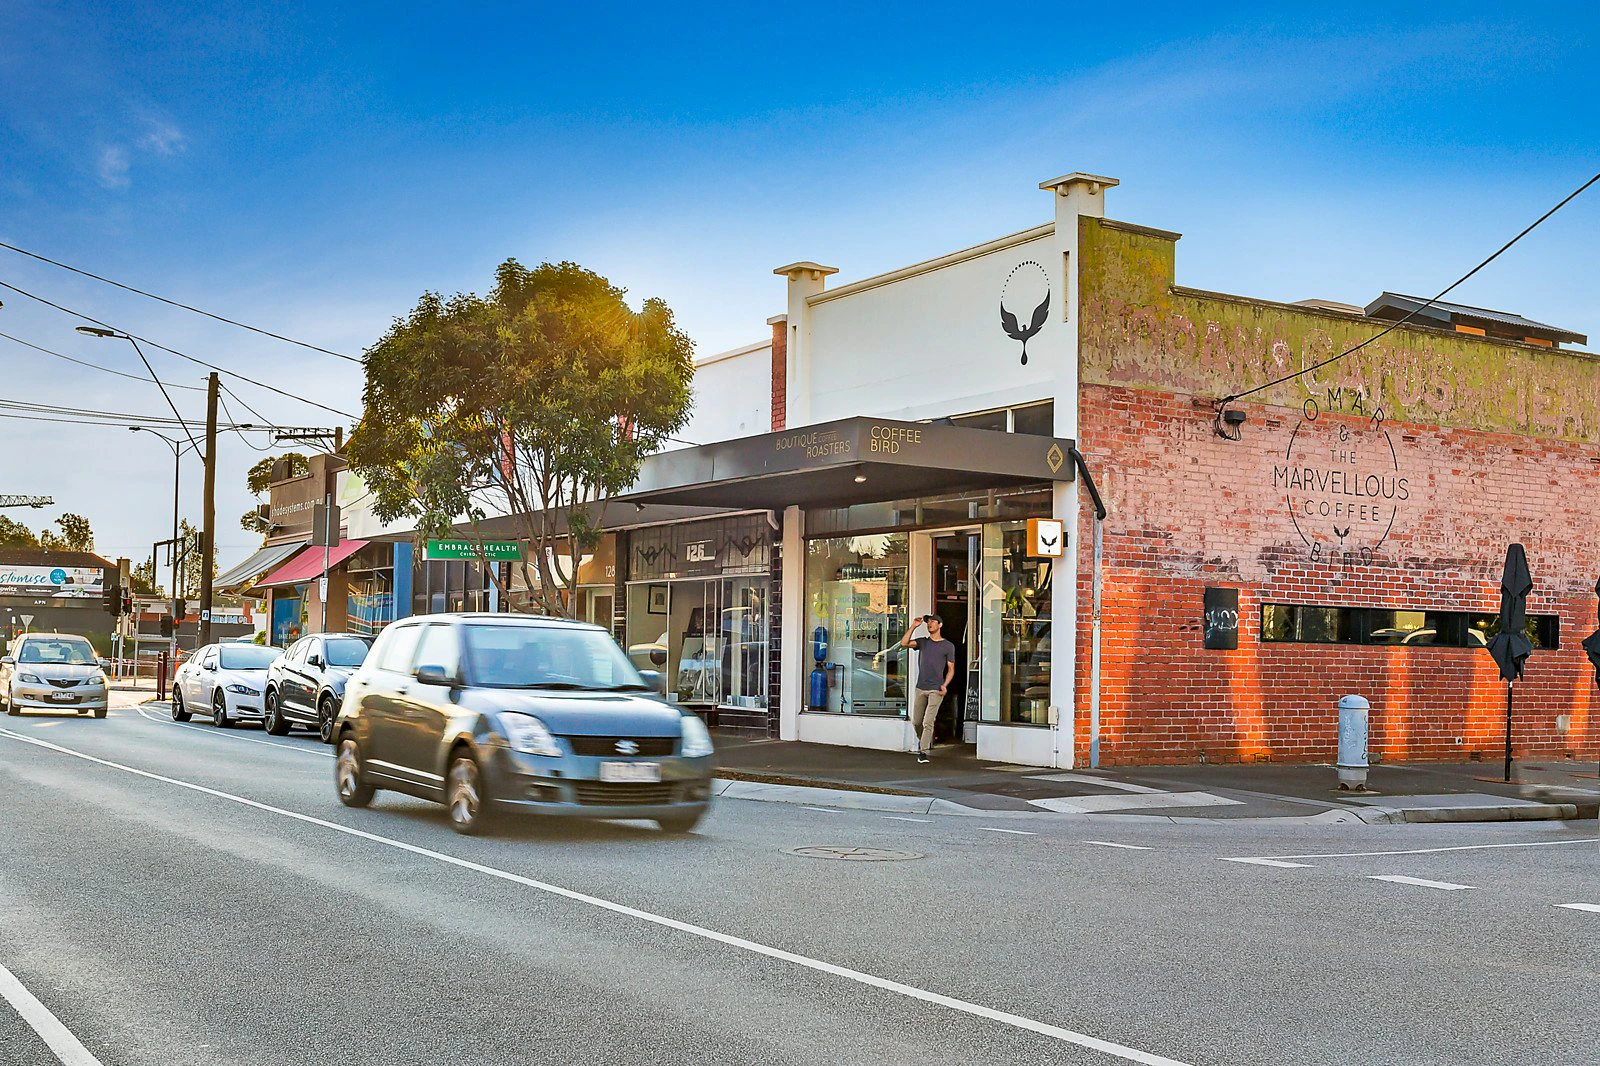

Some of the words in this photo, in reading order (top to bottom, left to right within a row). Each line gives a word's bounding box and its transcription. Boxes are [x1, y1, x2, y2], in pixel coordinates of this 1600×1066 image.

[1303, 386, 1385, 431] OMAR
[775, 432, 818, 450] BOUTIQUE
[870, 425, 922, 443] COFFEE
[1339, 425, 1349, 441] &
[806, 440, 850, 458] ROASTERS
[870, 438, 900, 454] BIRD
[1330, 449, 1356, 464] THE
[1273, 465, 1410, 500] MARVELLOUS
[1304, 500, 1380, 522] COFFEE
[438, 543, 480, 551] EMBRACE
[483, 544, 518, 552] HEALTH
[686, 544, 705, 562] 126
[1310, 542, 1373, 572] BIRD
[605, 565, 616, 577] 128
